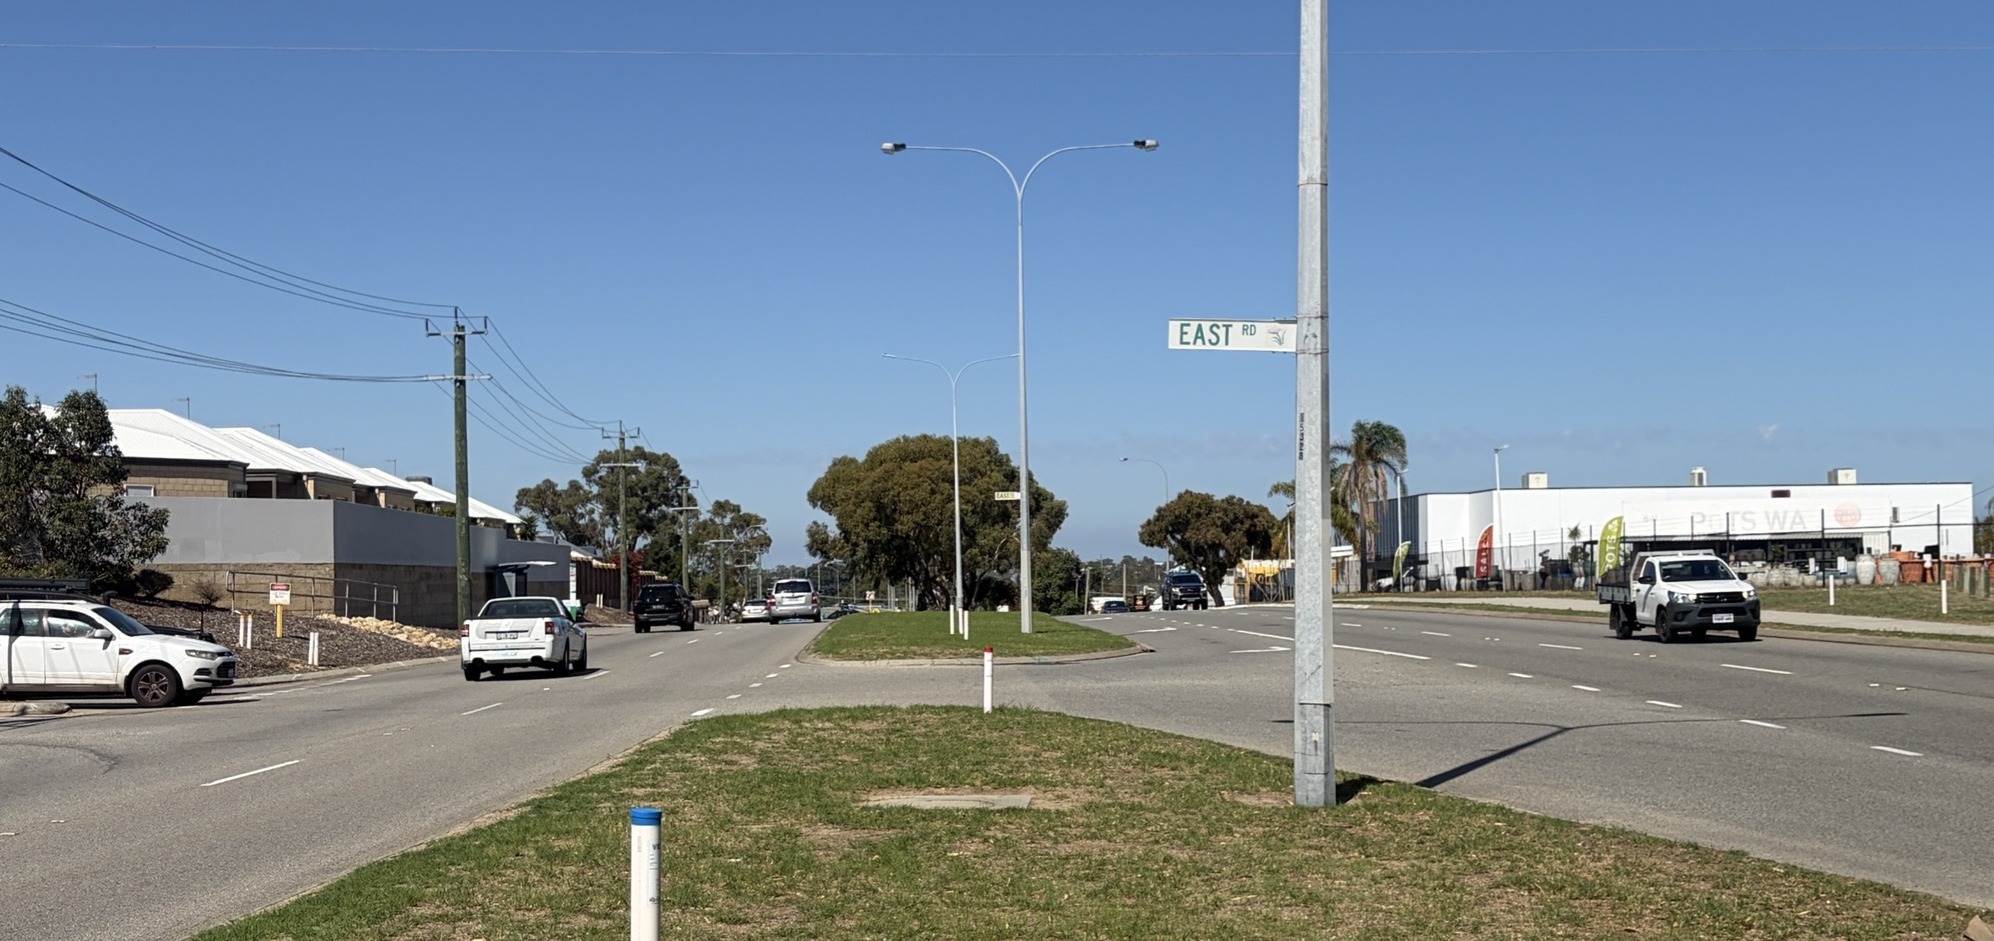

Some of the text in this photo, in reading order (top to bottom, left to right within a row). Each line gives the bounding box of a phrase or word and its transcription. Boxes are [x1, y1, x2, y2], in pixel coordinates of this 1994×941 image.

[1179, 323, 1257, 346] EAST RD
[1763, 510, 1808, 531] WA
[1479, 541, 1489, 573] SALE
[1604, 535, 1617, 572] POTS
